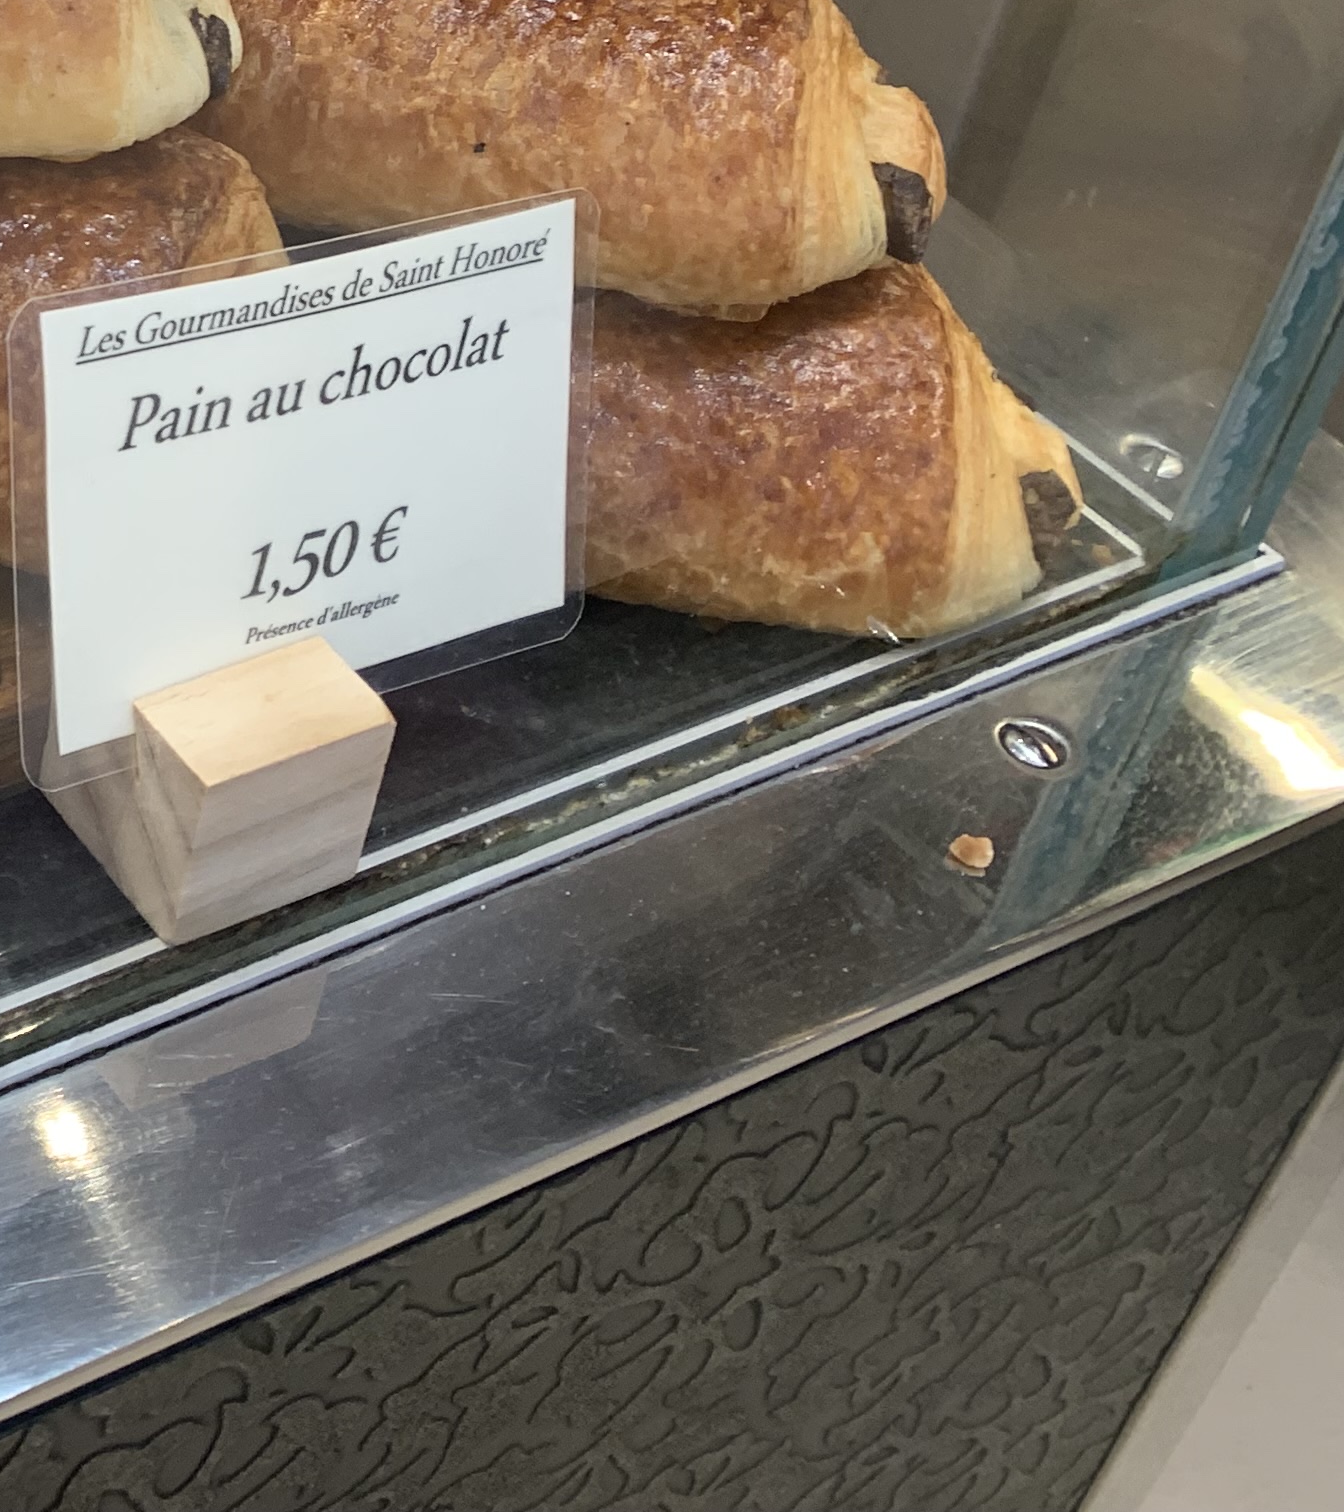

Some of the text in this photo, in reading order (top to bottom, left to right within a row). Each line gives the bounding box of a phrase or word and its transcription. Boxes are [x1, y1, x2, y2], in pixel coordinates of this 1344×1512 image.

[77, 228, 552, 360] Les Gourmandises de Saint Honoré
[117, 315, 511, 451] Pain au chocolat
[244, 590, 400, 645] Présence d'allergène
